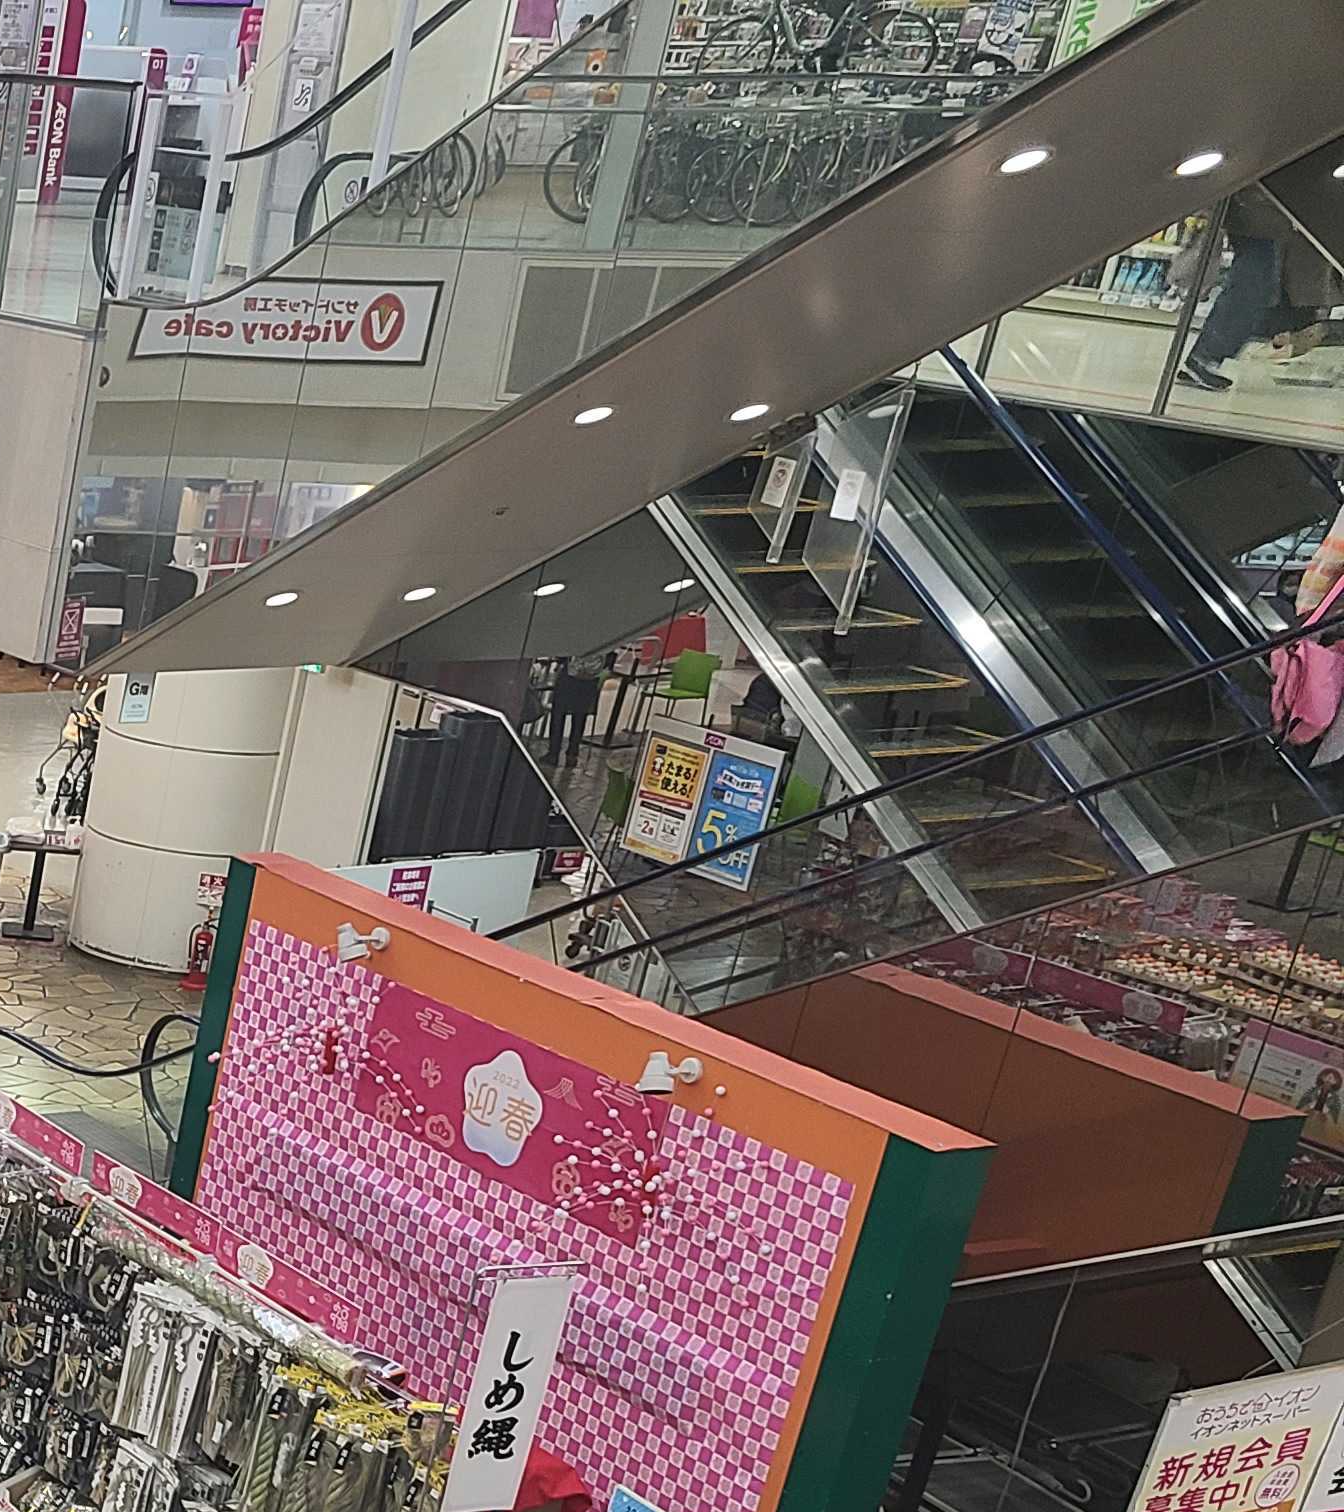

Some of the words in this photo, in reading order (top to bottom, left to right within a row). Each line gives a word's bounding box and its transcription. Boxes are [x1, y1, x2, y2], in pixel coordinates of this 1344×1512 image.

[152, 58, 165, 71] 01
[44, 148, 62, 187] Bank
[466, 1076, 537, 1141] 迎春
[467, 1331, 535, 1460] しめ縄
[1189, 1408, 1312, 1441] イオンネットスーパー
[1152, 1427, 1312, 1492] 新規会員
